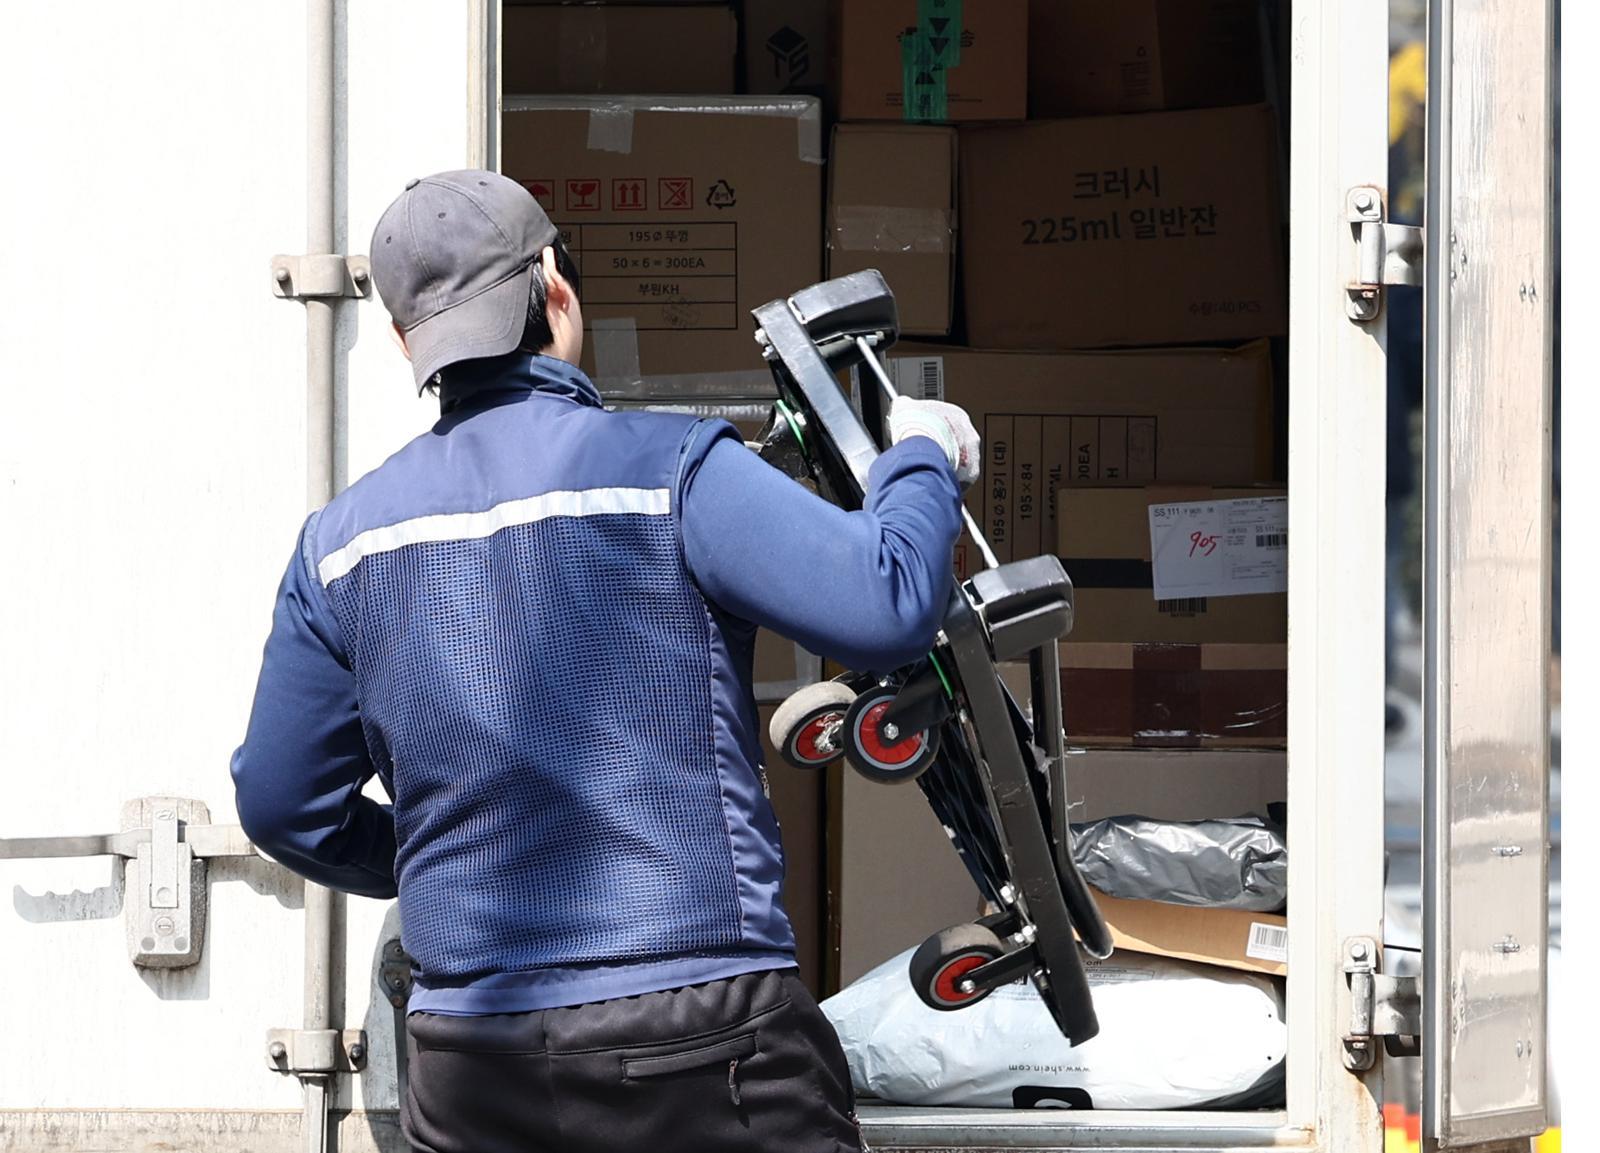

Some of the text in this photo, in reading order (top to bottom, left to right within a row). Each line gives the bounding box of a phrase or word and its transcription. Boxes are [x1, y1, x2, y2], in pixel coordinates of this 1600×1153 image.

[1072, 165, 1161, 200] 크러시
[1021, 204, 1218, 245] 225ml 일반잔
[666, 257, 705, 269] 300EA
[1188, 530, 1222, 558] 905
[1008, 1065, 1090, 1076] www.shein.com
